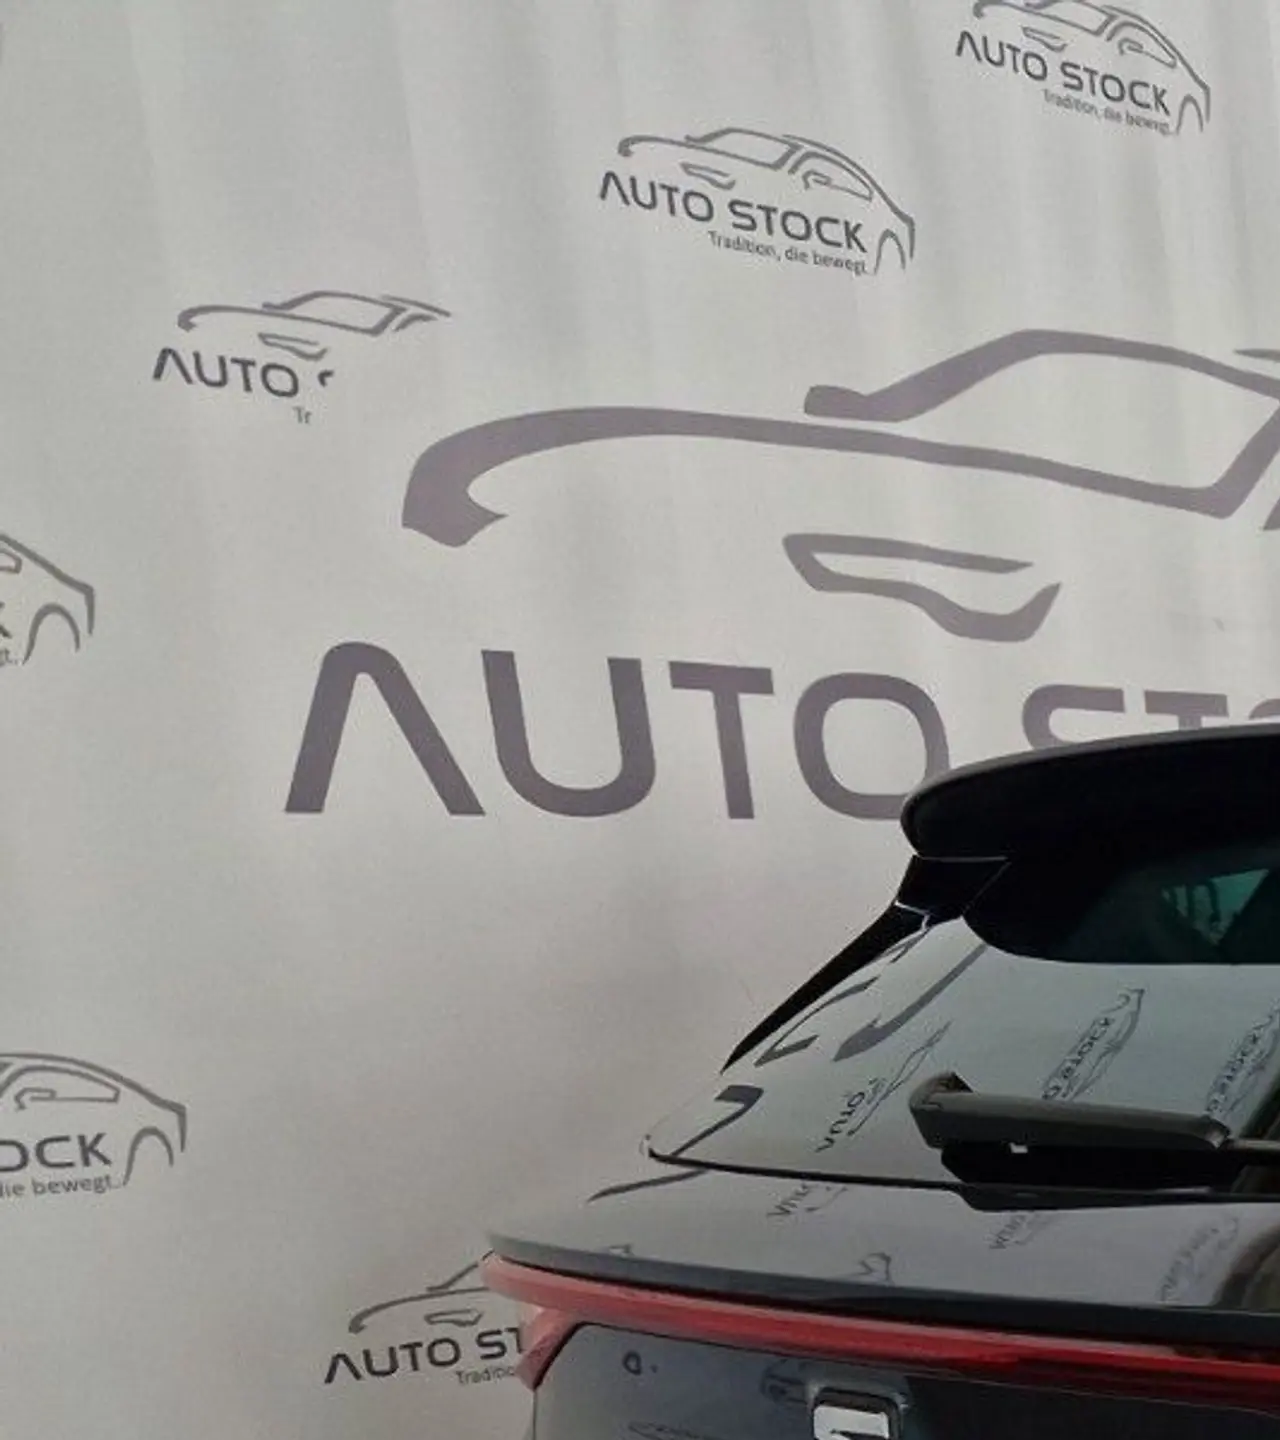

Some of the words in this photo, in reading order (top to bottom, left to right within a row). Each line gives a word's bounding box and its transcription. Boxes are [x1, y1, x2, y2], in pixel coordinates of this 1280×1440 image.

[955, 30, 1048, 81] AUTO
[1060, 61, 1171, 117] STOCK
[599, 170, 714, 223] AUTO
[727, 199, 868, 254] STOCK
[153, 347, 300, 398] AUTO
[284, 640, 952, 821] AUTO
[324, 1337, 461, 1384] AUTO
